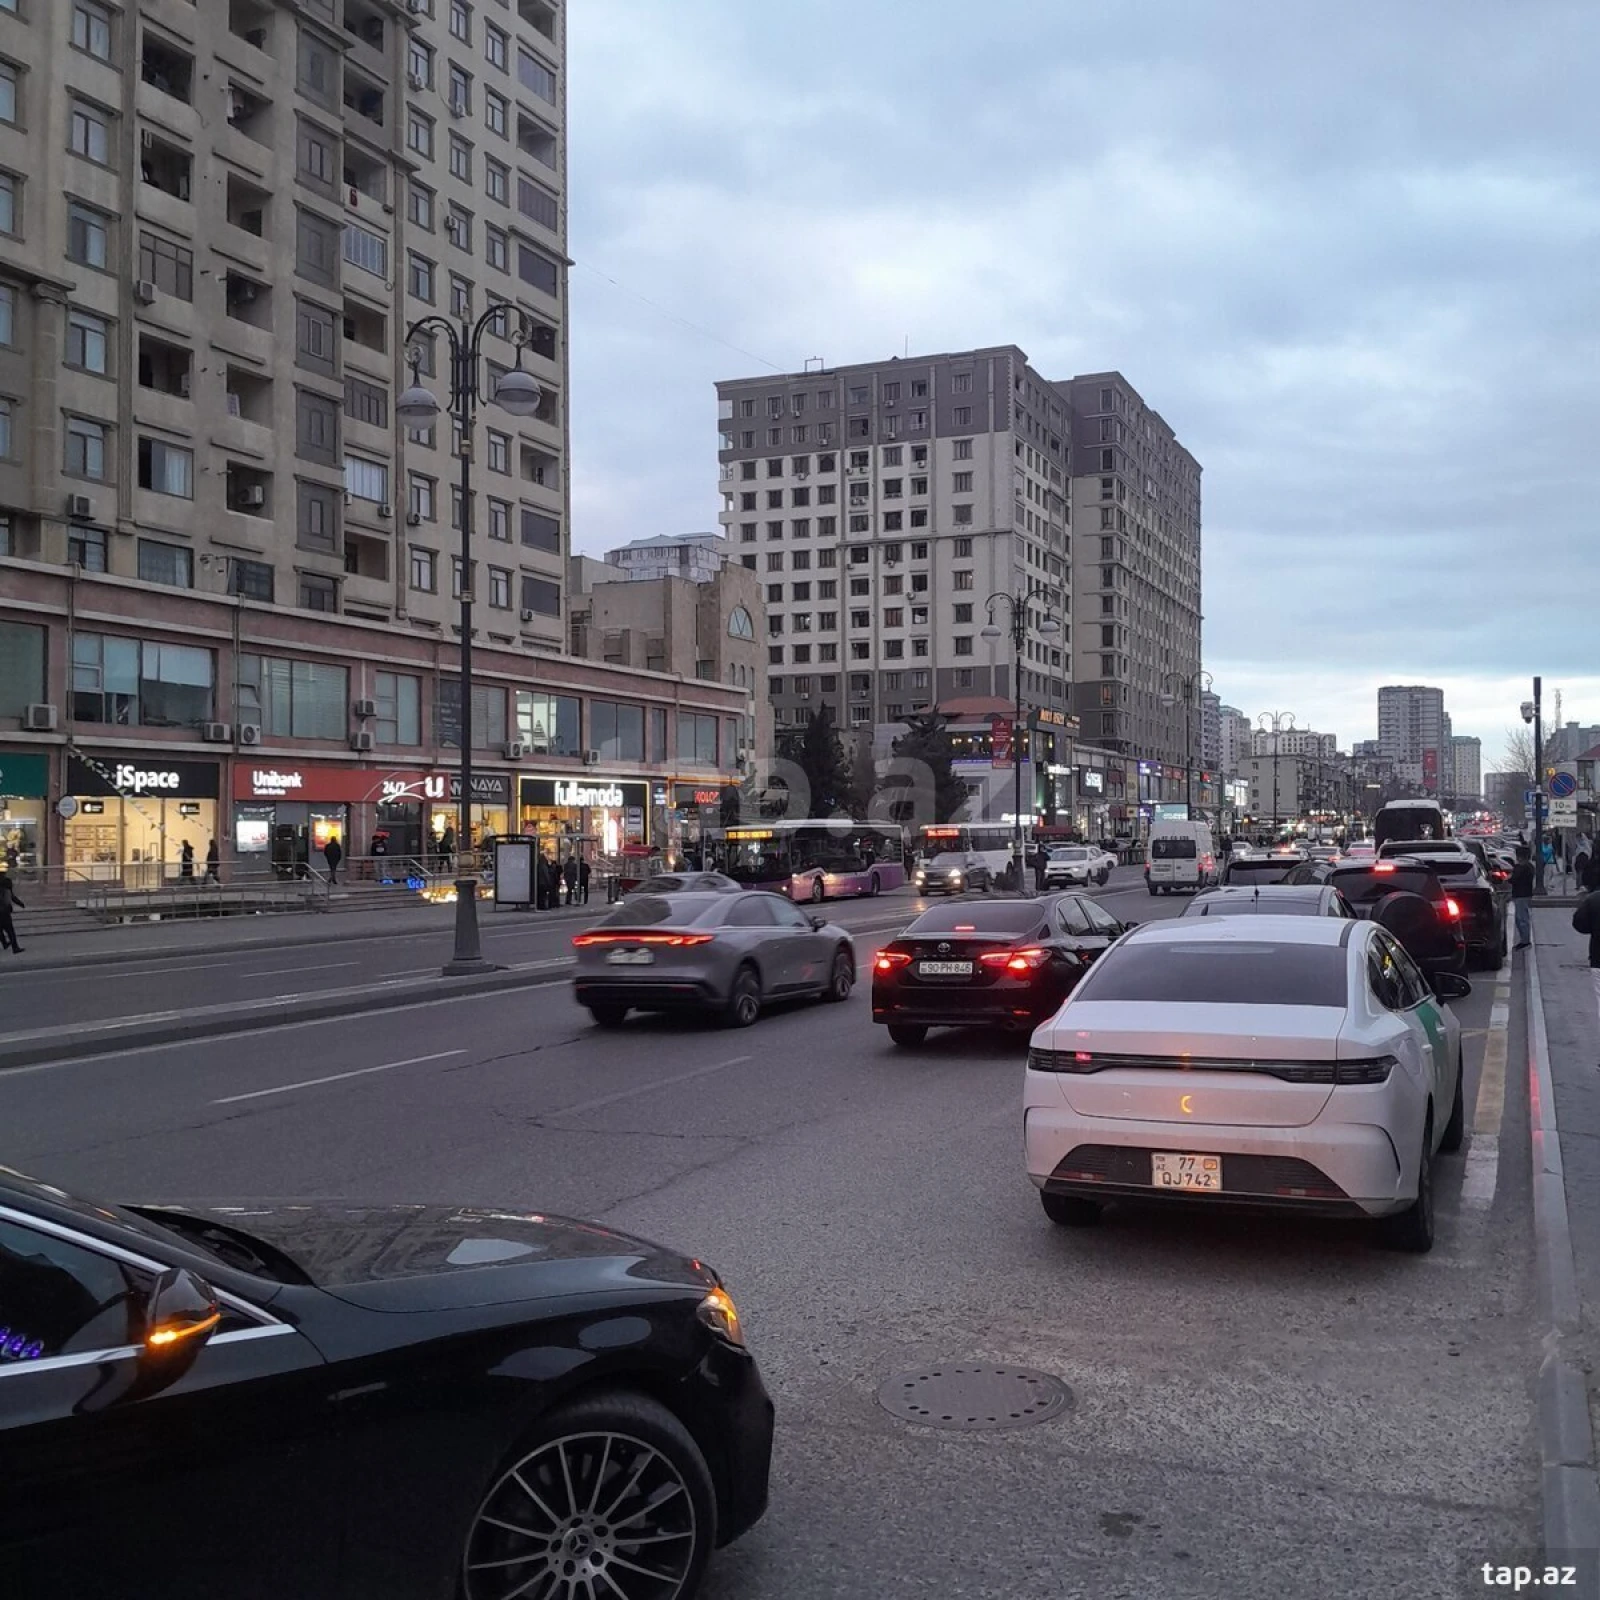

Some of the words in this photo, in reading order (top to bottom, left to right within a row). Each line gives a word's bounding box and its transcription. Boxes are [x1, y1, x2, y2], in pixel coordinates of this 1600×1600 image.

[116, 764, 180, 792] iSpace
[252, 770, 302, 788] Unibank
[1179, 1157, 1195, 1170] 77
